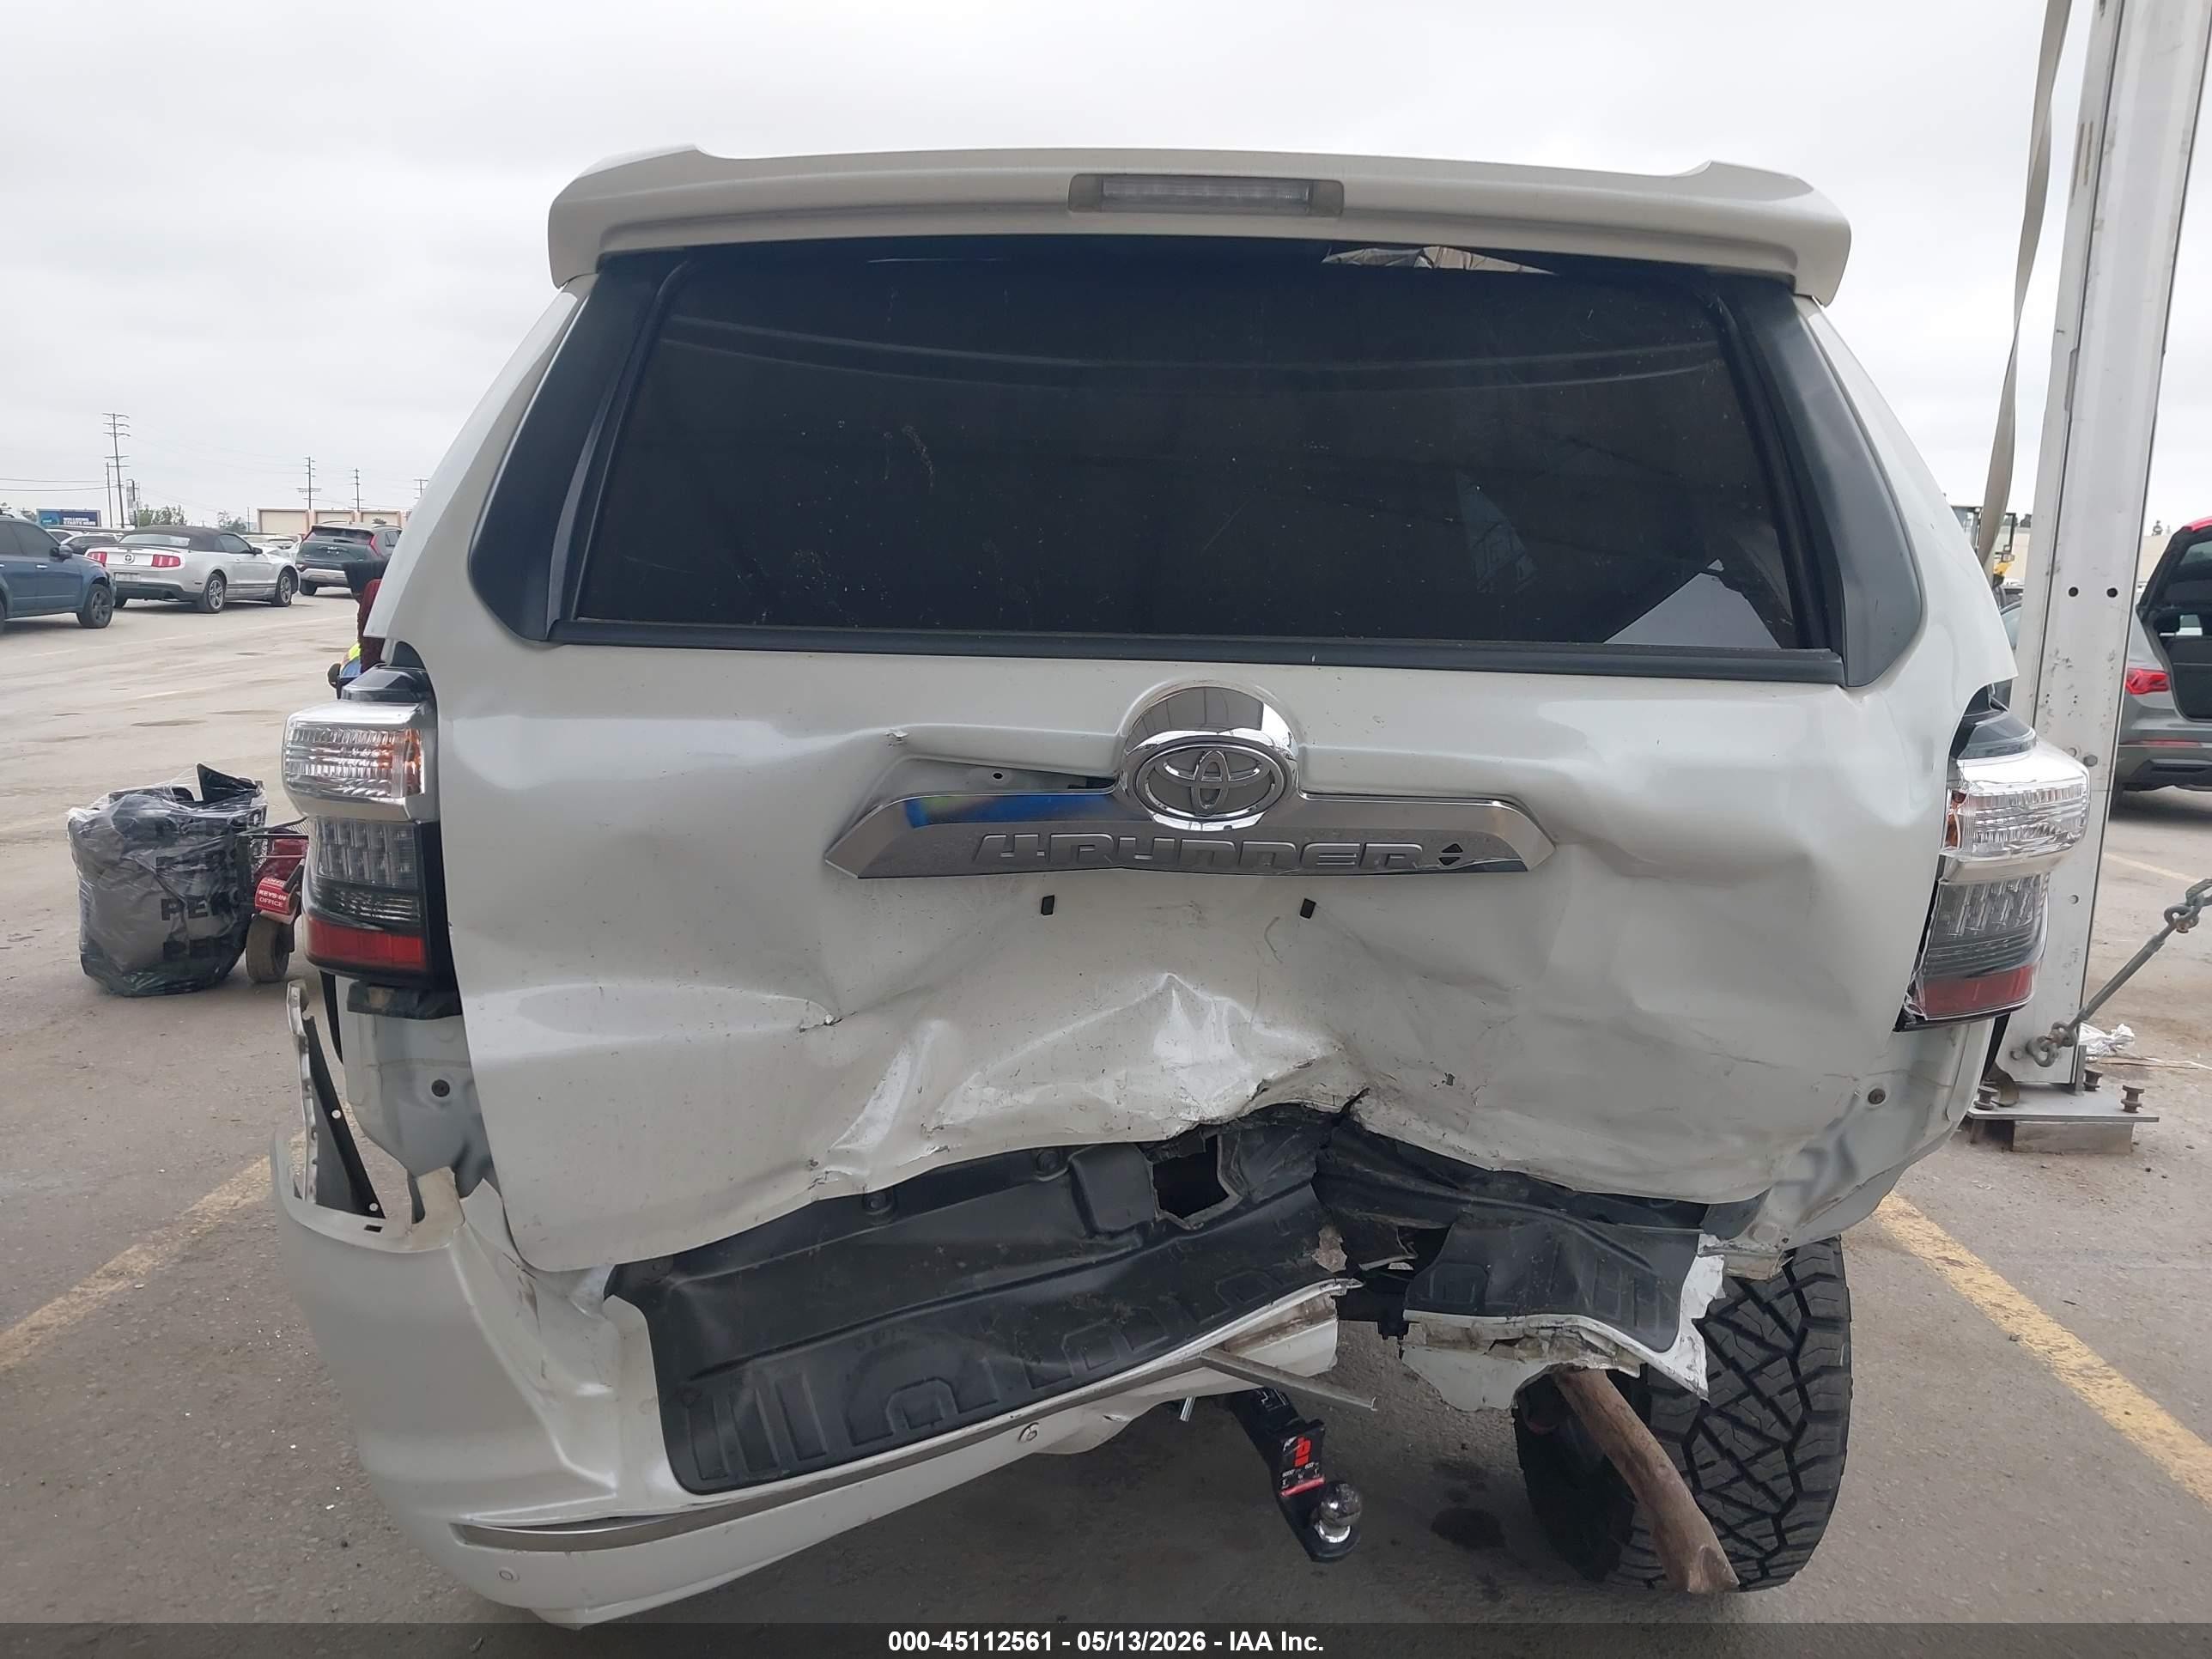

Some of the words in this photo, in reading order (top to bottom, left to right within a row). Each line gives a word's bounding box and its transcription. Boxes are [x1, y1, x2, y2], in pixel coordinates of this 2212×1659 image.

[975, 833, 1424, 869] 4RUNNER
[258, 889, 277, 898] KEYS
[259, 896, 283, 908] OFFICE
